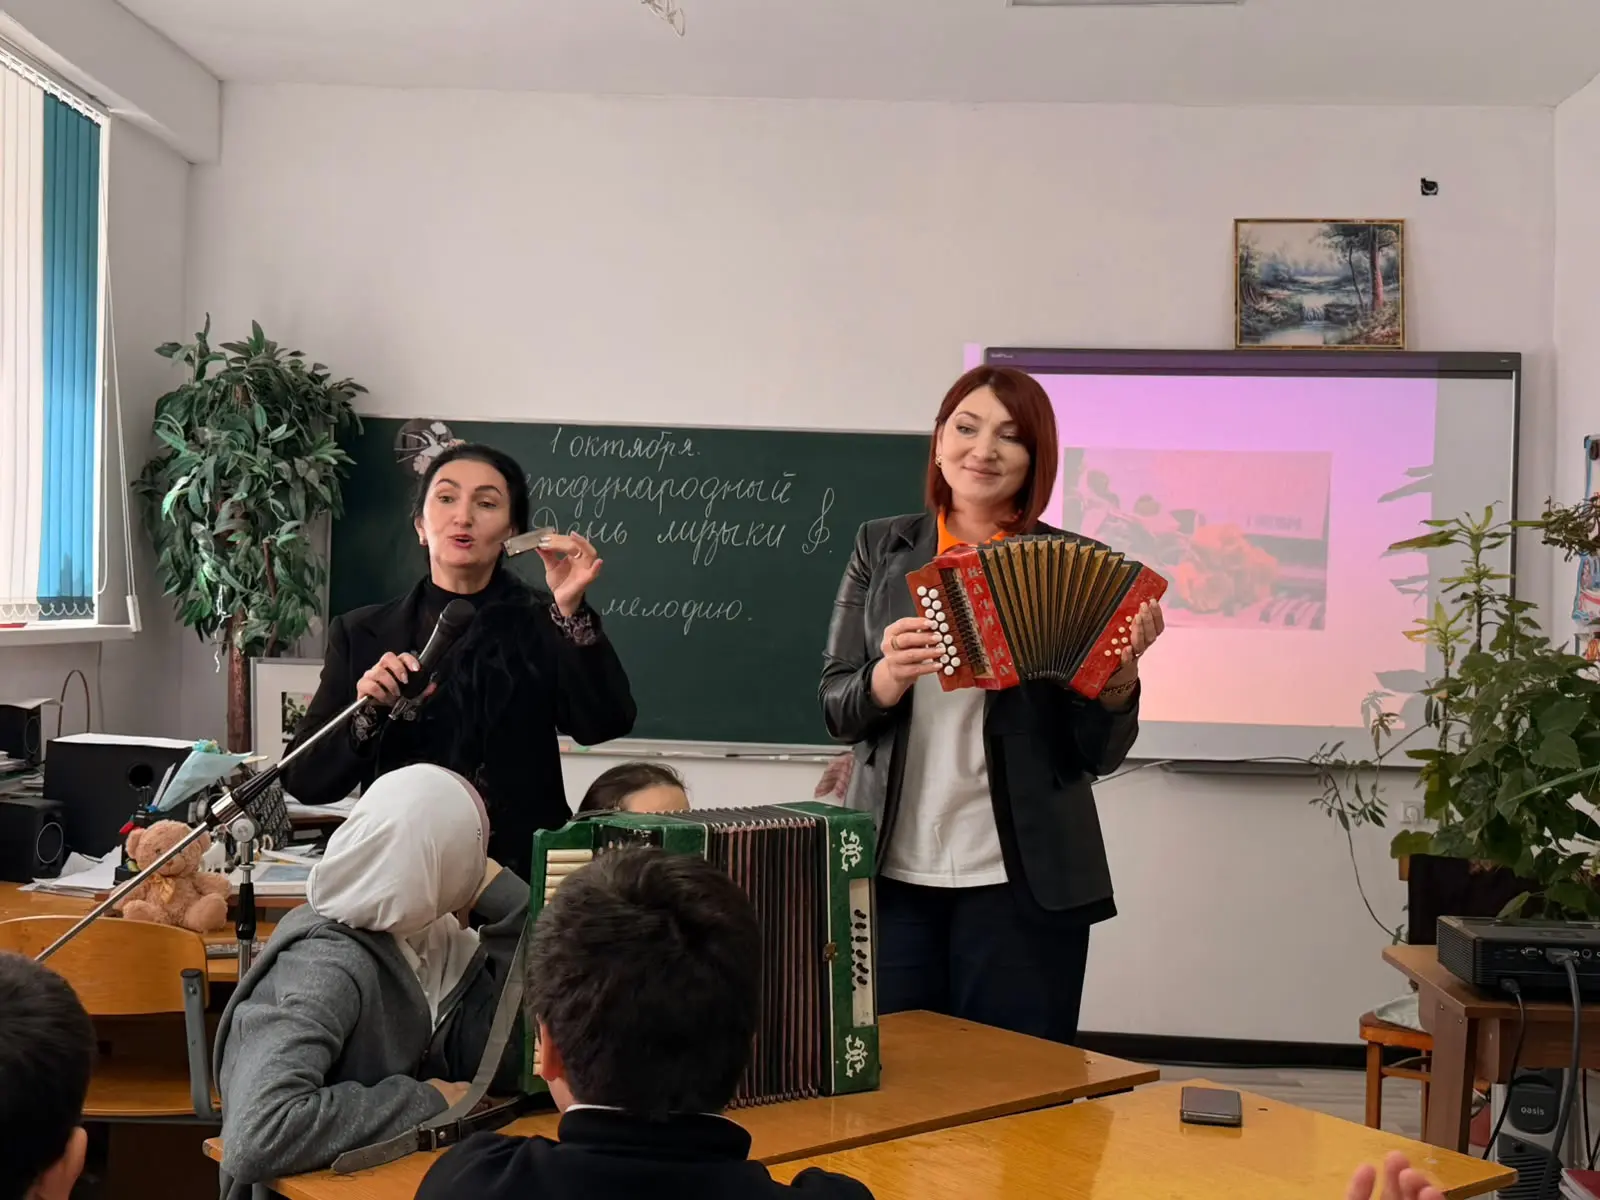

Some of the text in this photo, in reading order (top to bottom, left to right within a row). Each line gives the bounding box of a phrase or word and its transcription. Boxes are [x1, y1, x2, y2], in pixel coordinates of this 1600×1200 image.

[550, 426, 700, 472] 1 октября.
[526, 472, 797, 518] ждународный
[657, 519, 786, 566] музыки
[601, 597, 753, 635] мелодию.
[1520, 1106, 1545, 1116] oasis
